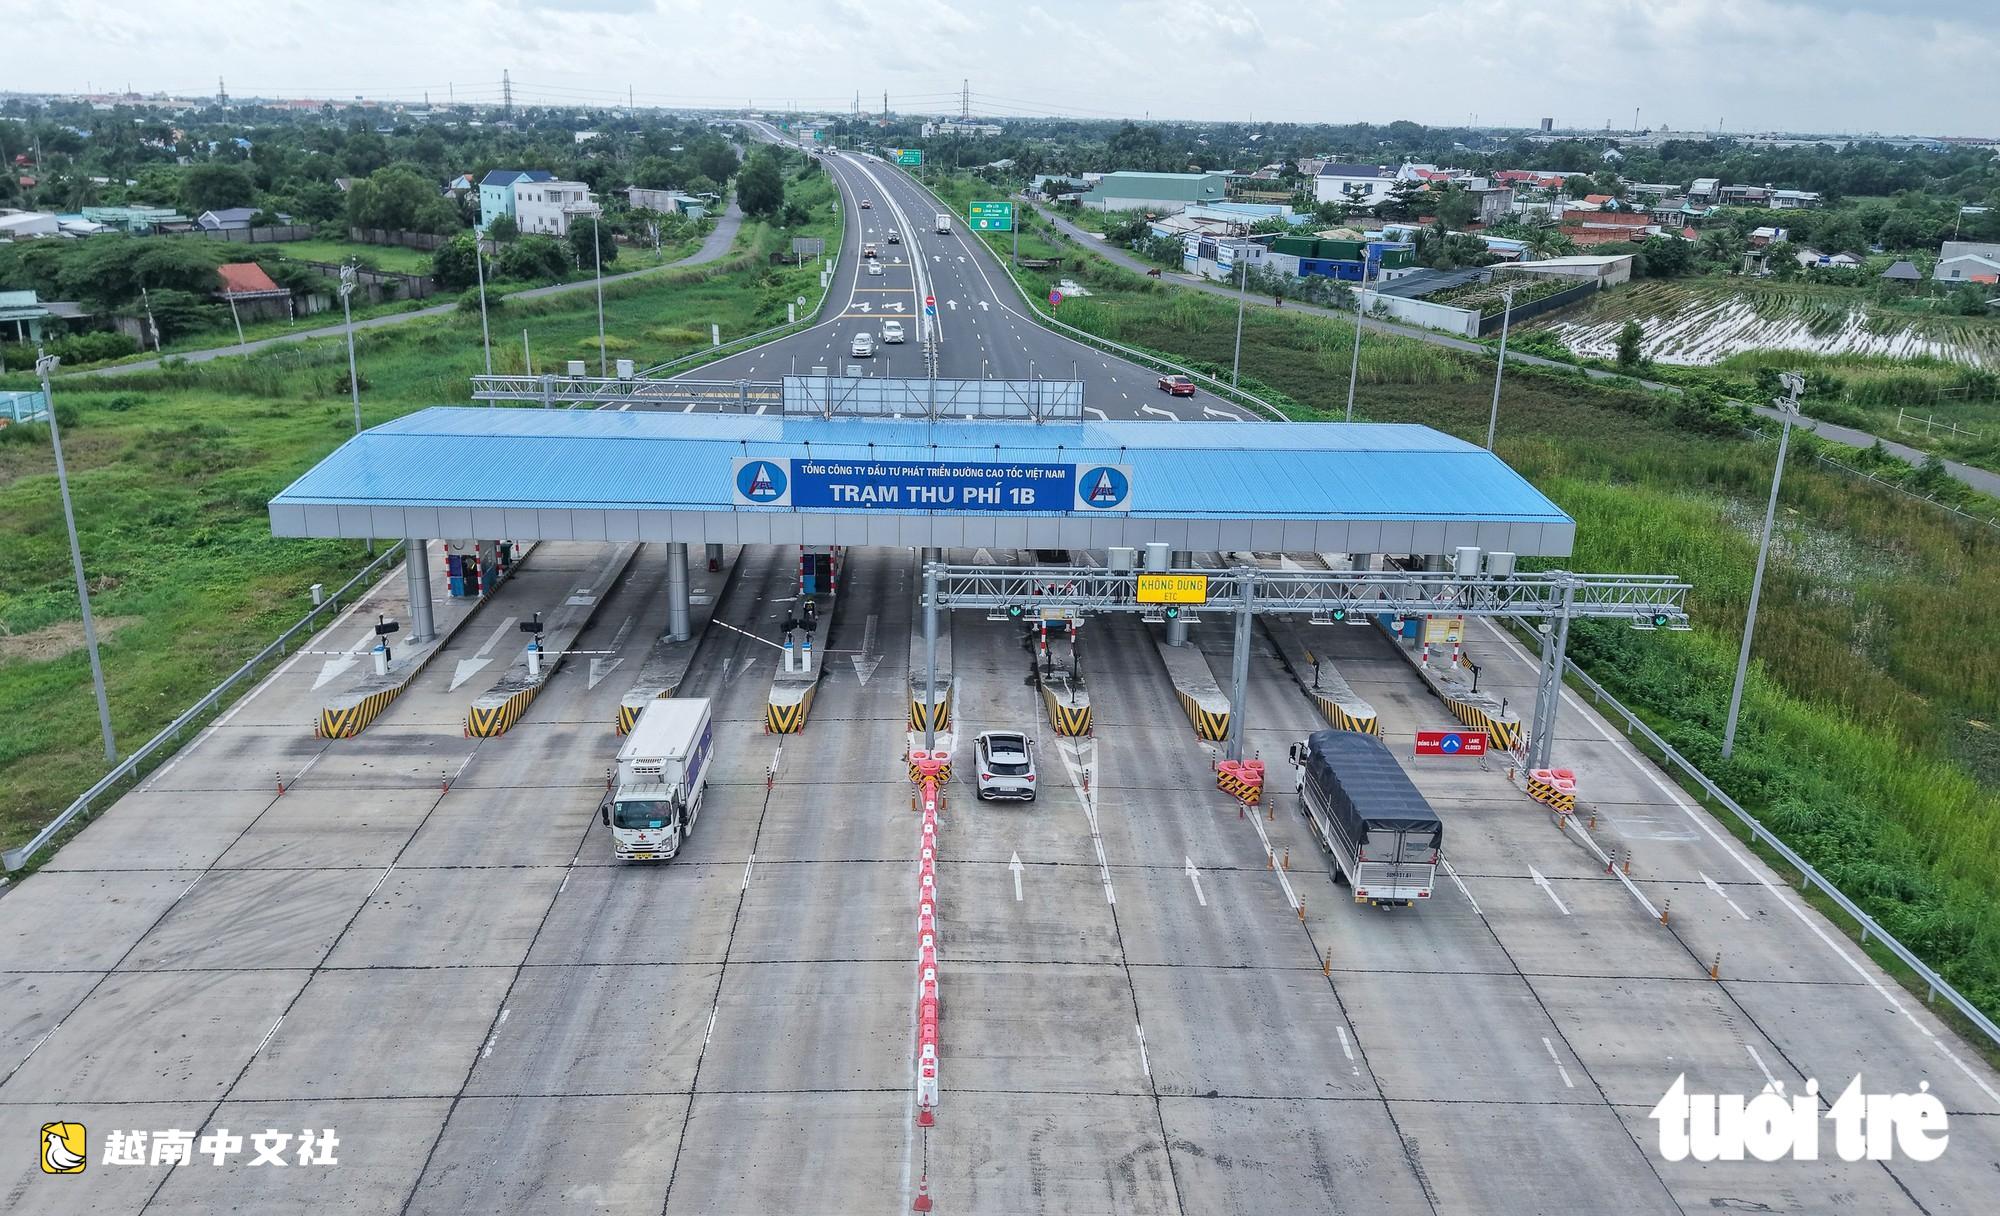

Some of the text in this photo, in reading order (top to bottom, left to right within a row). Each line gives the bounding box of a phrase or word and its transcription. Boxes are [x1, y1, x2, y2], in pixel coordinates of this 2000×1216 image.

[802, 461, 1066, 480] TỔNG CÔNG TY ĐẦU TƯ PHÁT TRIỂN ĐƯỜNG CAO TỐC VIỆT NAM
[829, 482, 1035, 507] TRẠM THU PHÍ 1B
[1164, 592, 1178, 601] ETC
